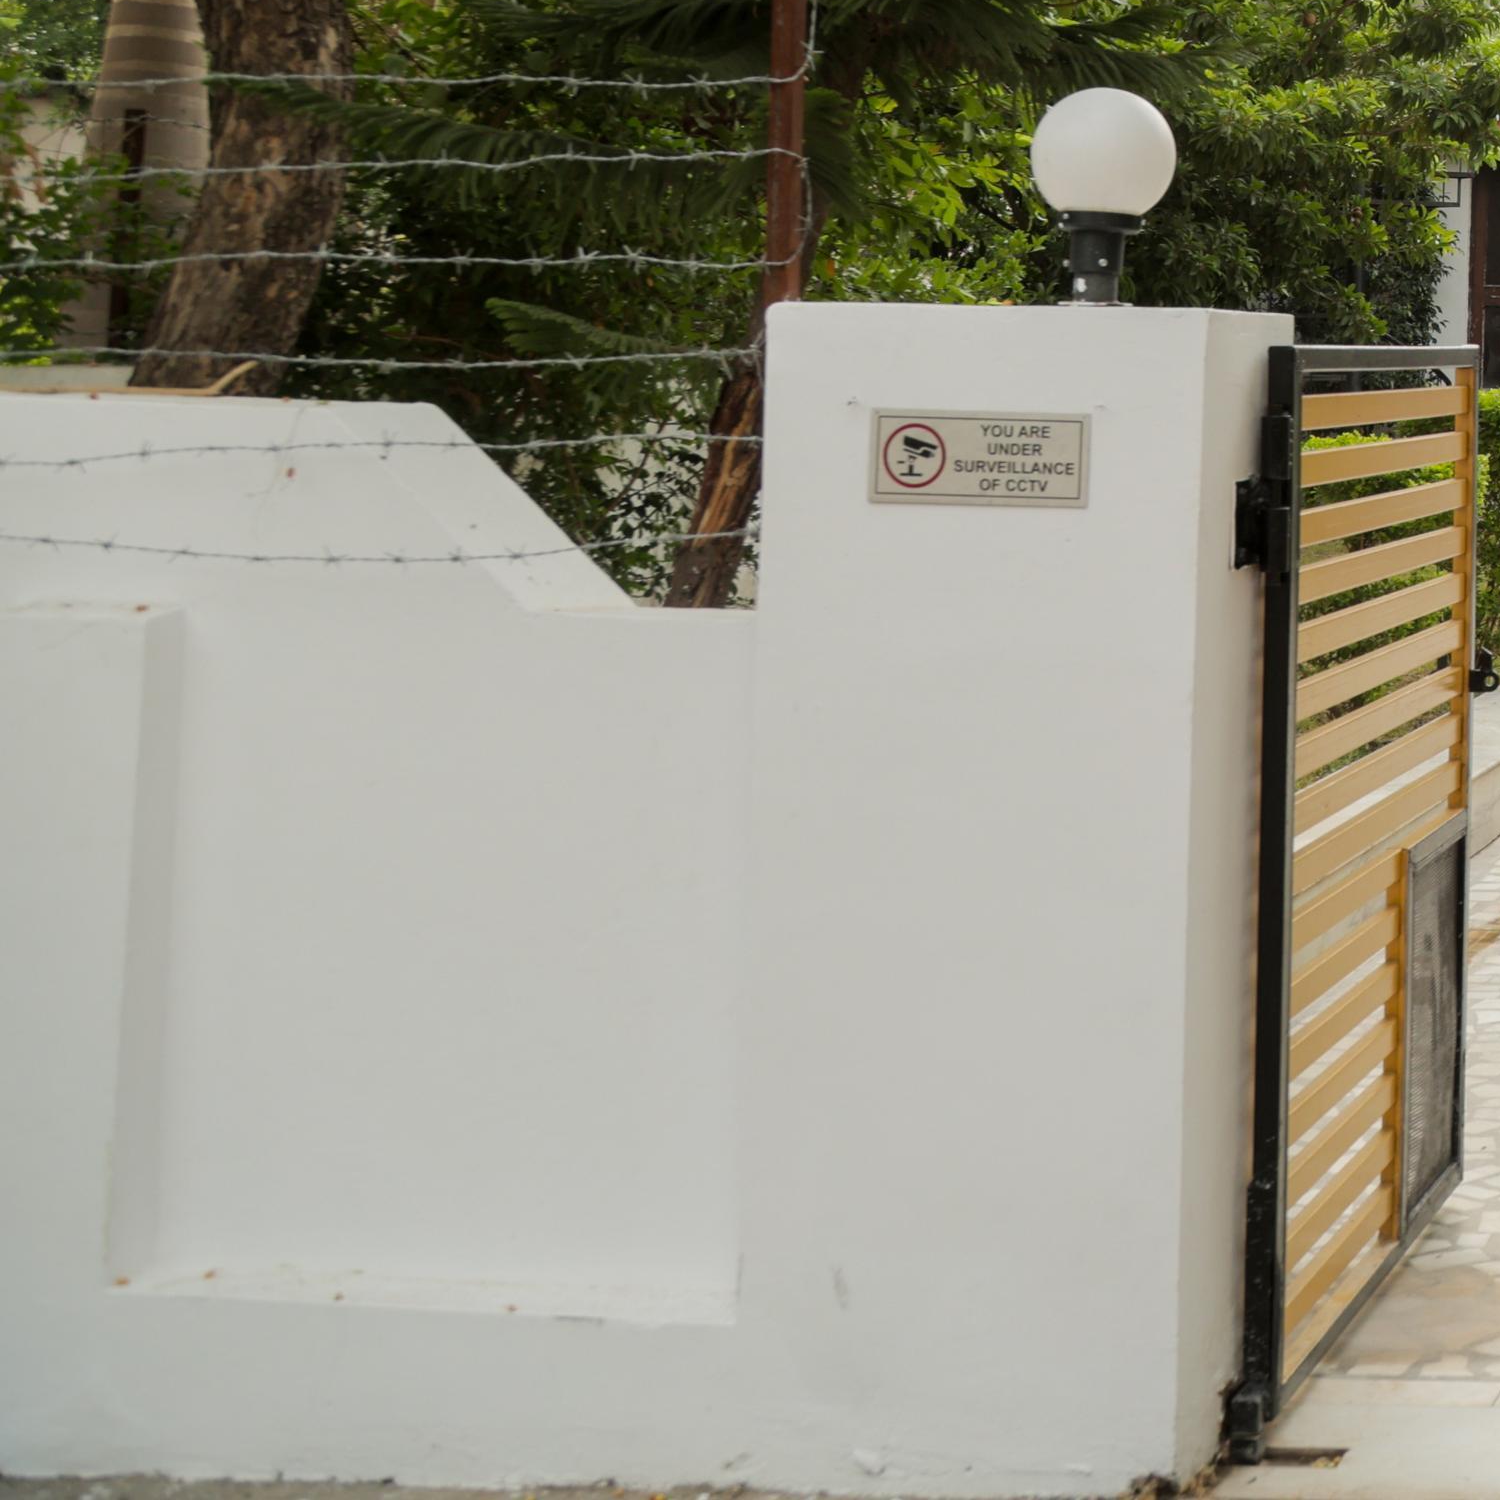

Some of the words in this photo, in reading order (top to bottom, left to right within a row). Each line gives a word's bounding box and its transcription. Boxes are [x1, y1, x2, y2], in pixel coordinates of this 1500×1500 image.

[980, 424, 1014, 439] YOU
[1018, 425, 1051, 439] ARE
[987, 443, 1043, 457] UNDER
[953, 459, 1075, 476] SURVEILLANCE
[979, 478, 1001, 492] OF
[1005, 479, 1049, 493] CCTV
